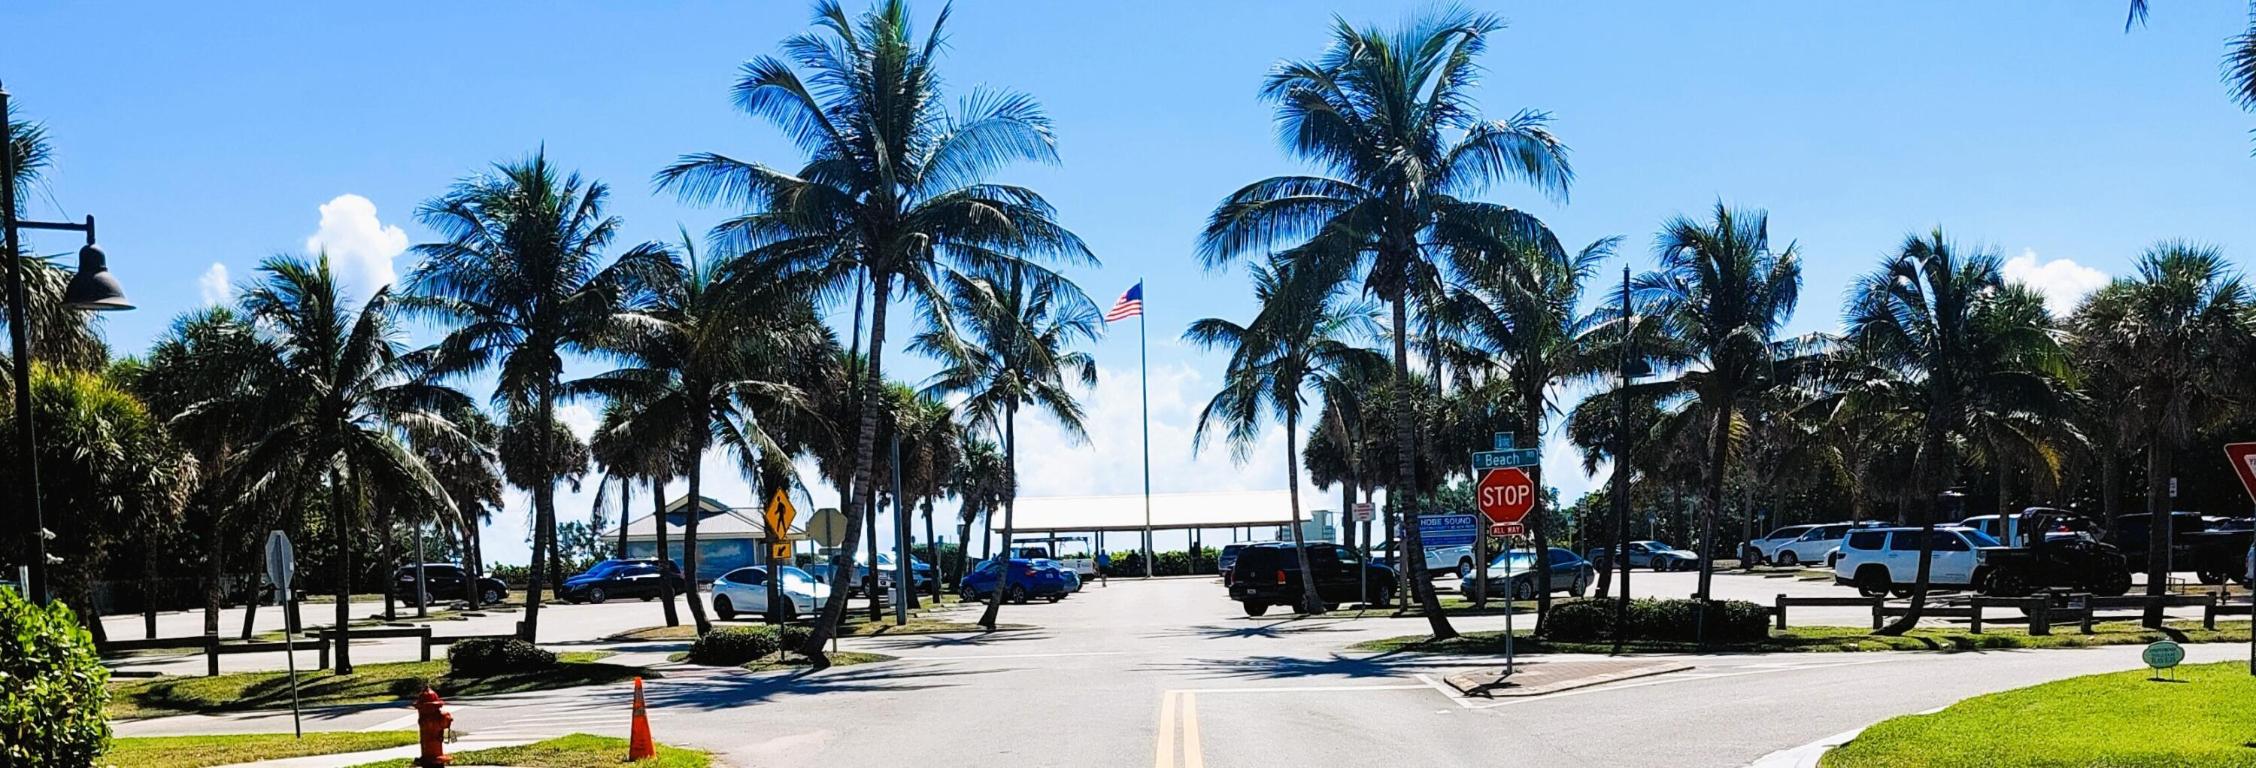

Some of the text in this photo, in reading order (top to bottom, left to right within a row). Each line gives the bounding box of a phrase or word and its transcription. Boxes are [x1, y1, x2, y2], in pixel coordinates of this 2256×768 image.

[1485, 453, 1520, 466] Beach
[1482, 484, 1530, 507] STOP
[1420, 517, 1471, 526] HOBE SOUND
